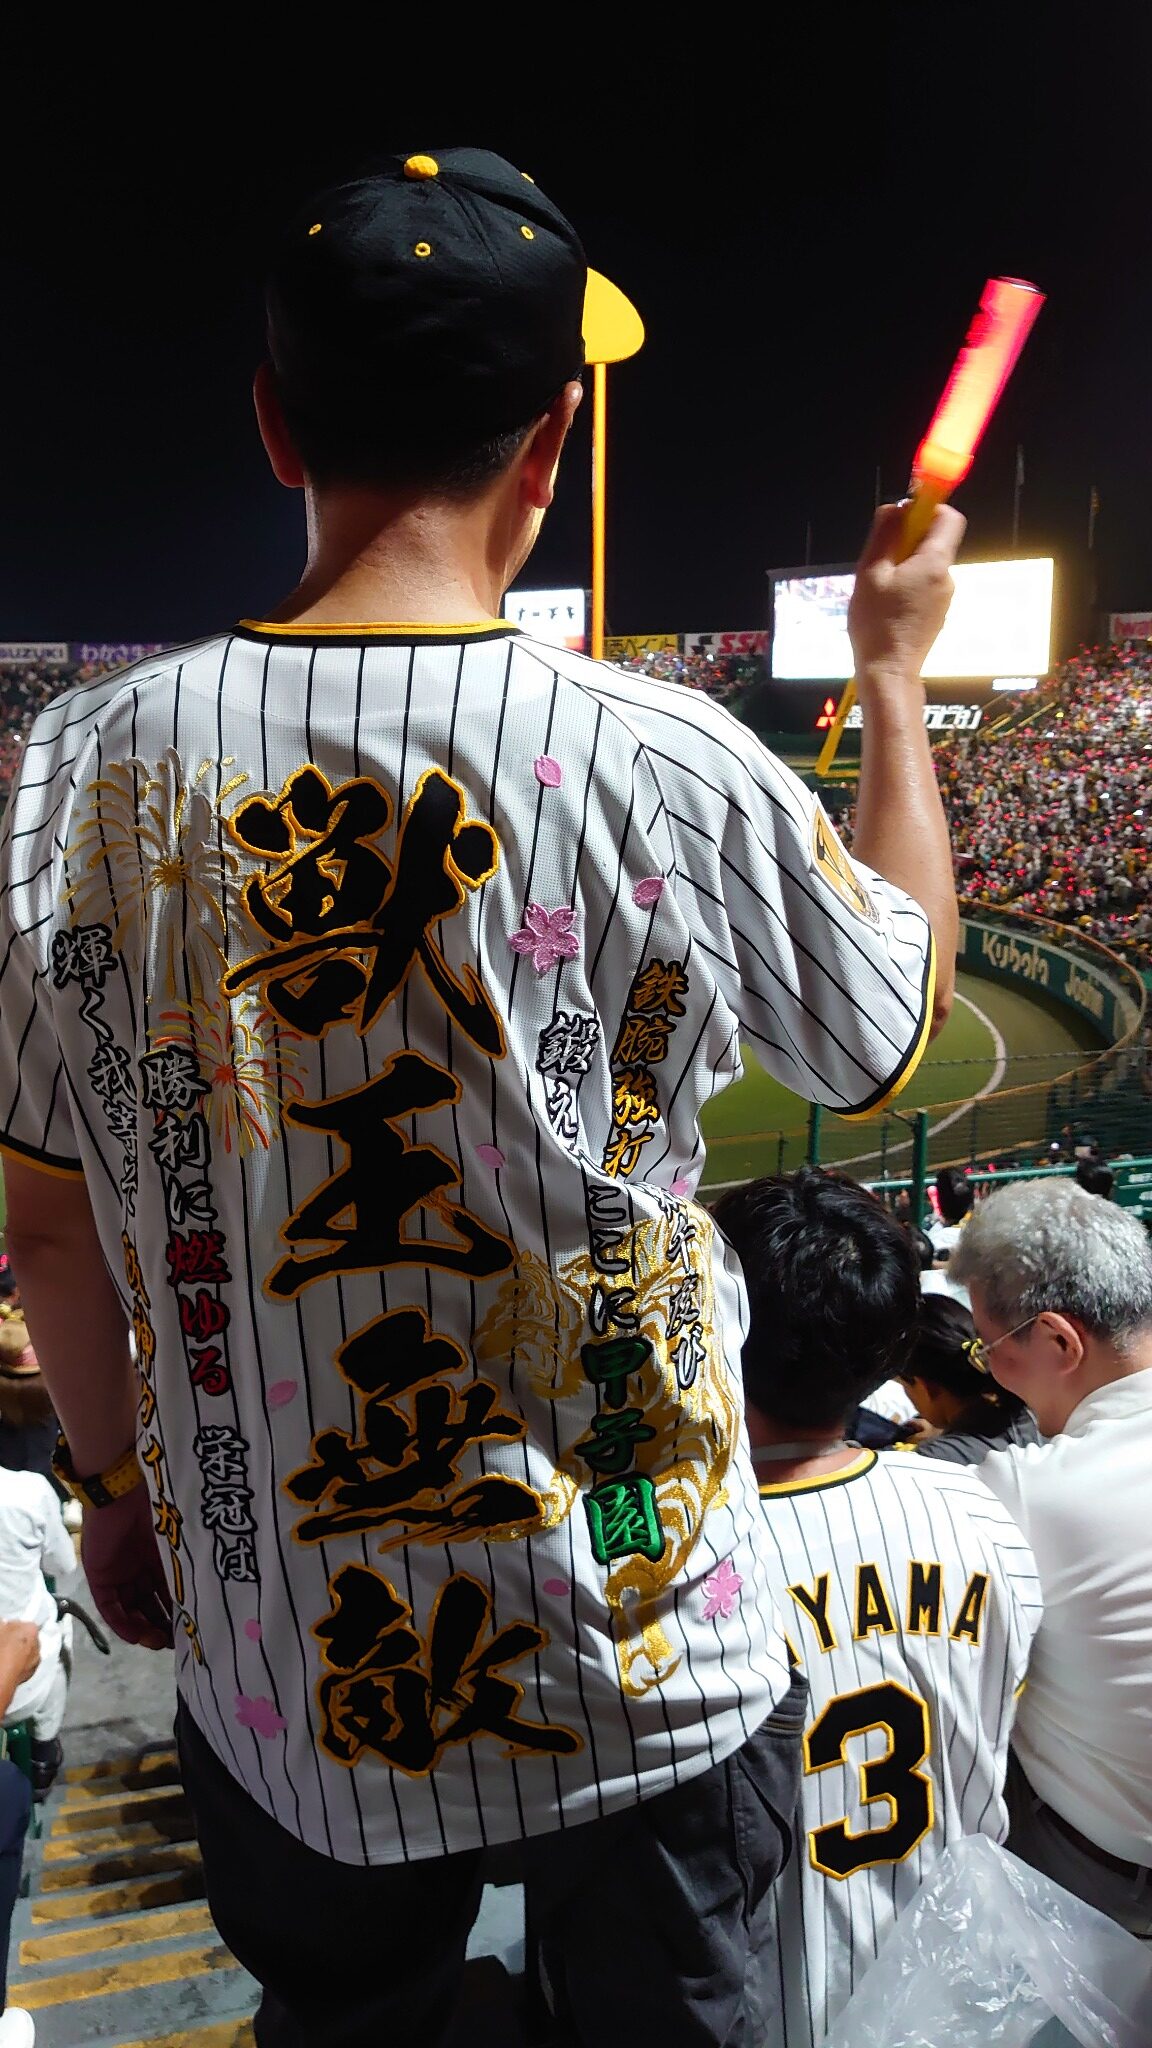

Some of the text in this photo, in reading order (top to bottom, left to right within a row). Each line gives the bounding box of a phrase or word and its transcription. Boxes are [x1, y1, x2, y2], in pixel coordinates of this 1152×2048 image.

[983, 930, 1049, 987] Kubota
[784, 1559, 991, 1668] YAMA
[803, 1679, 934, 1882] 3
